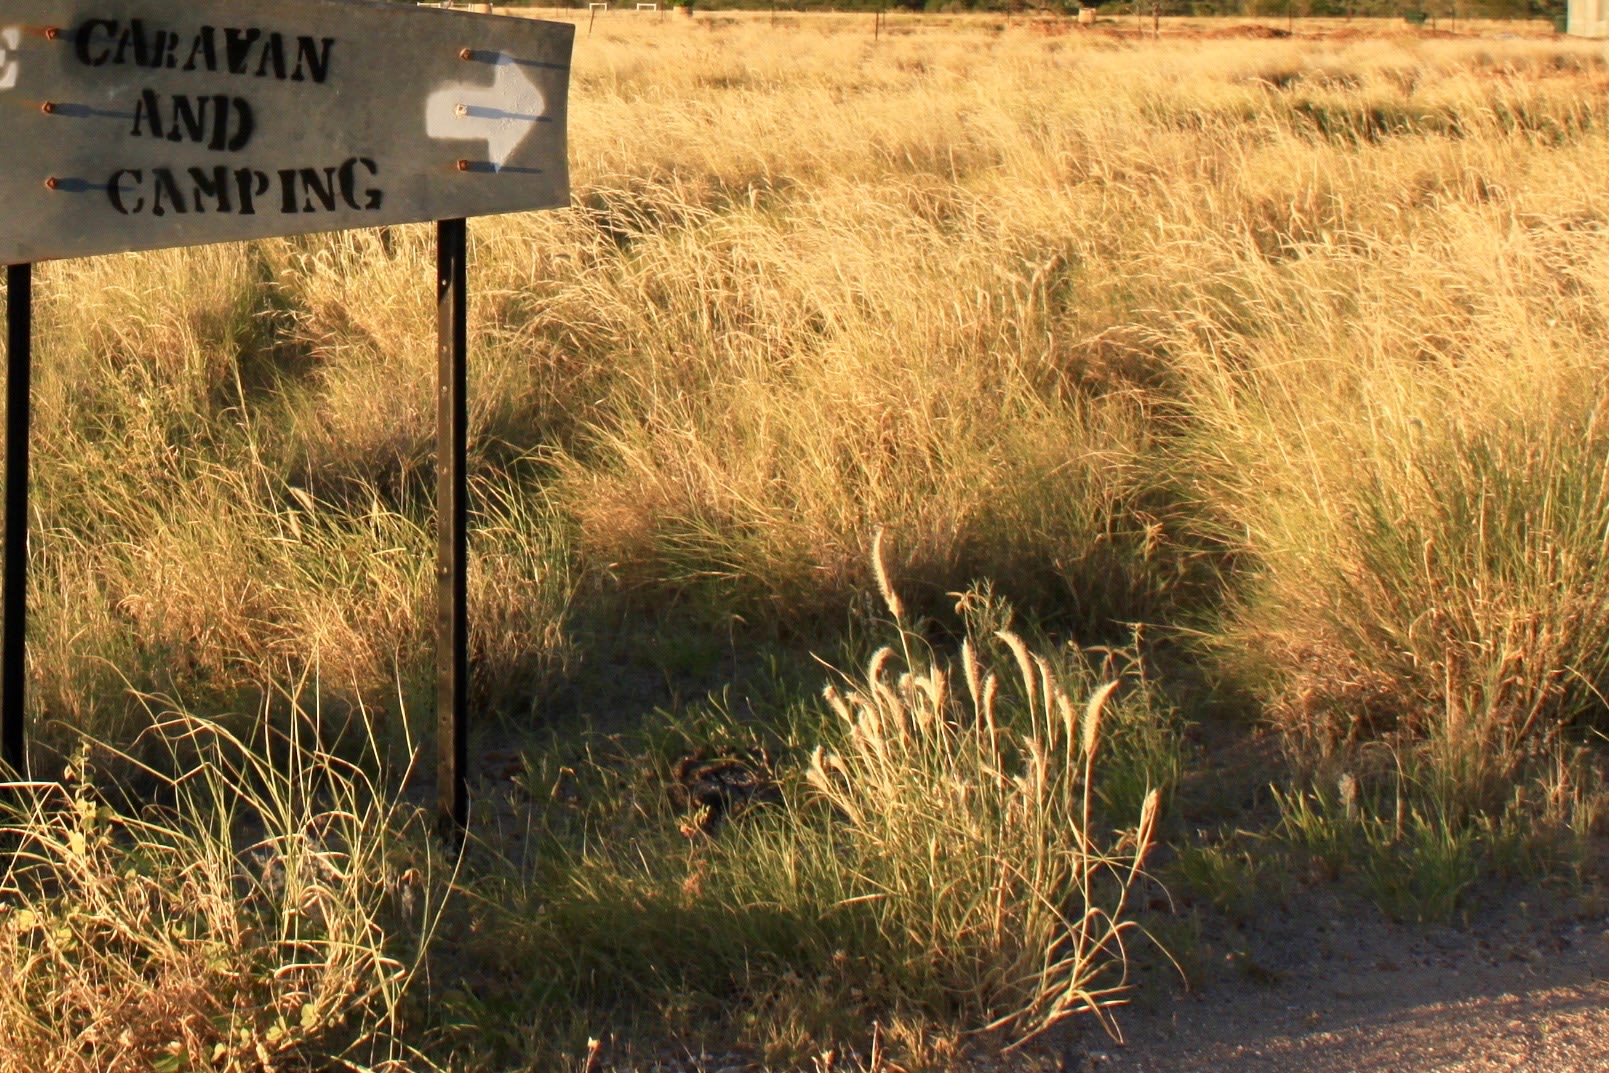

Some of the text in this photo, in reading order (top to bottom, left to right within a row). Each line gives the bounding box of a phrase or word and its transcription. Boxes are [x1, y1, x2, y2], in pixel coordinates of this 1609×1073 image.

[75, 17, 337, 84] CARAVAN
[130, 88, 255, 152] AND
[107, 156, 384, 217] CAMPING
